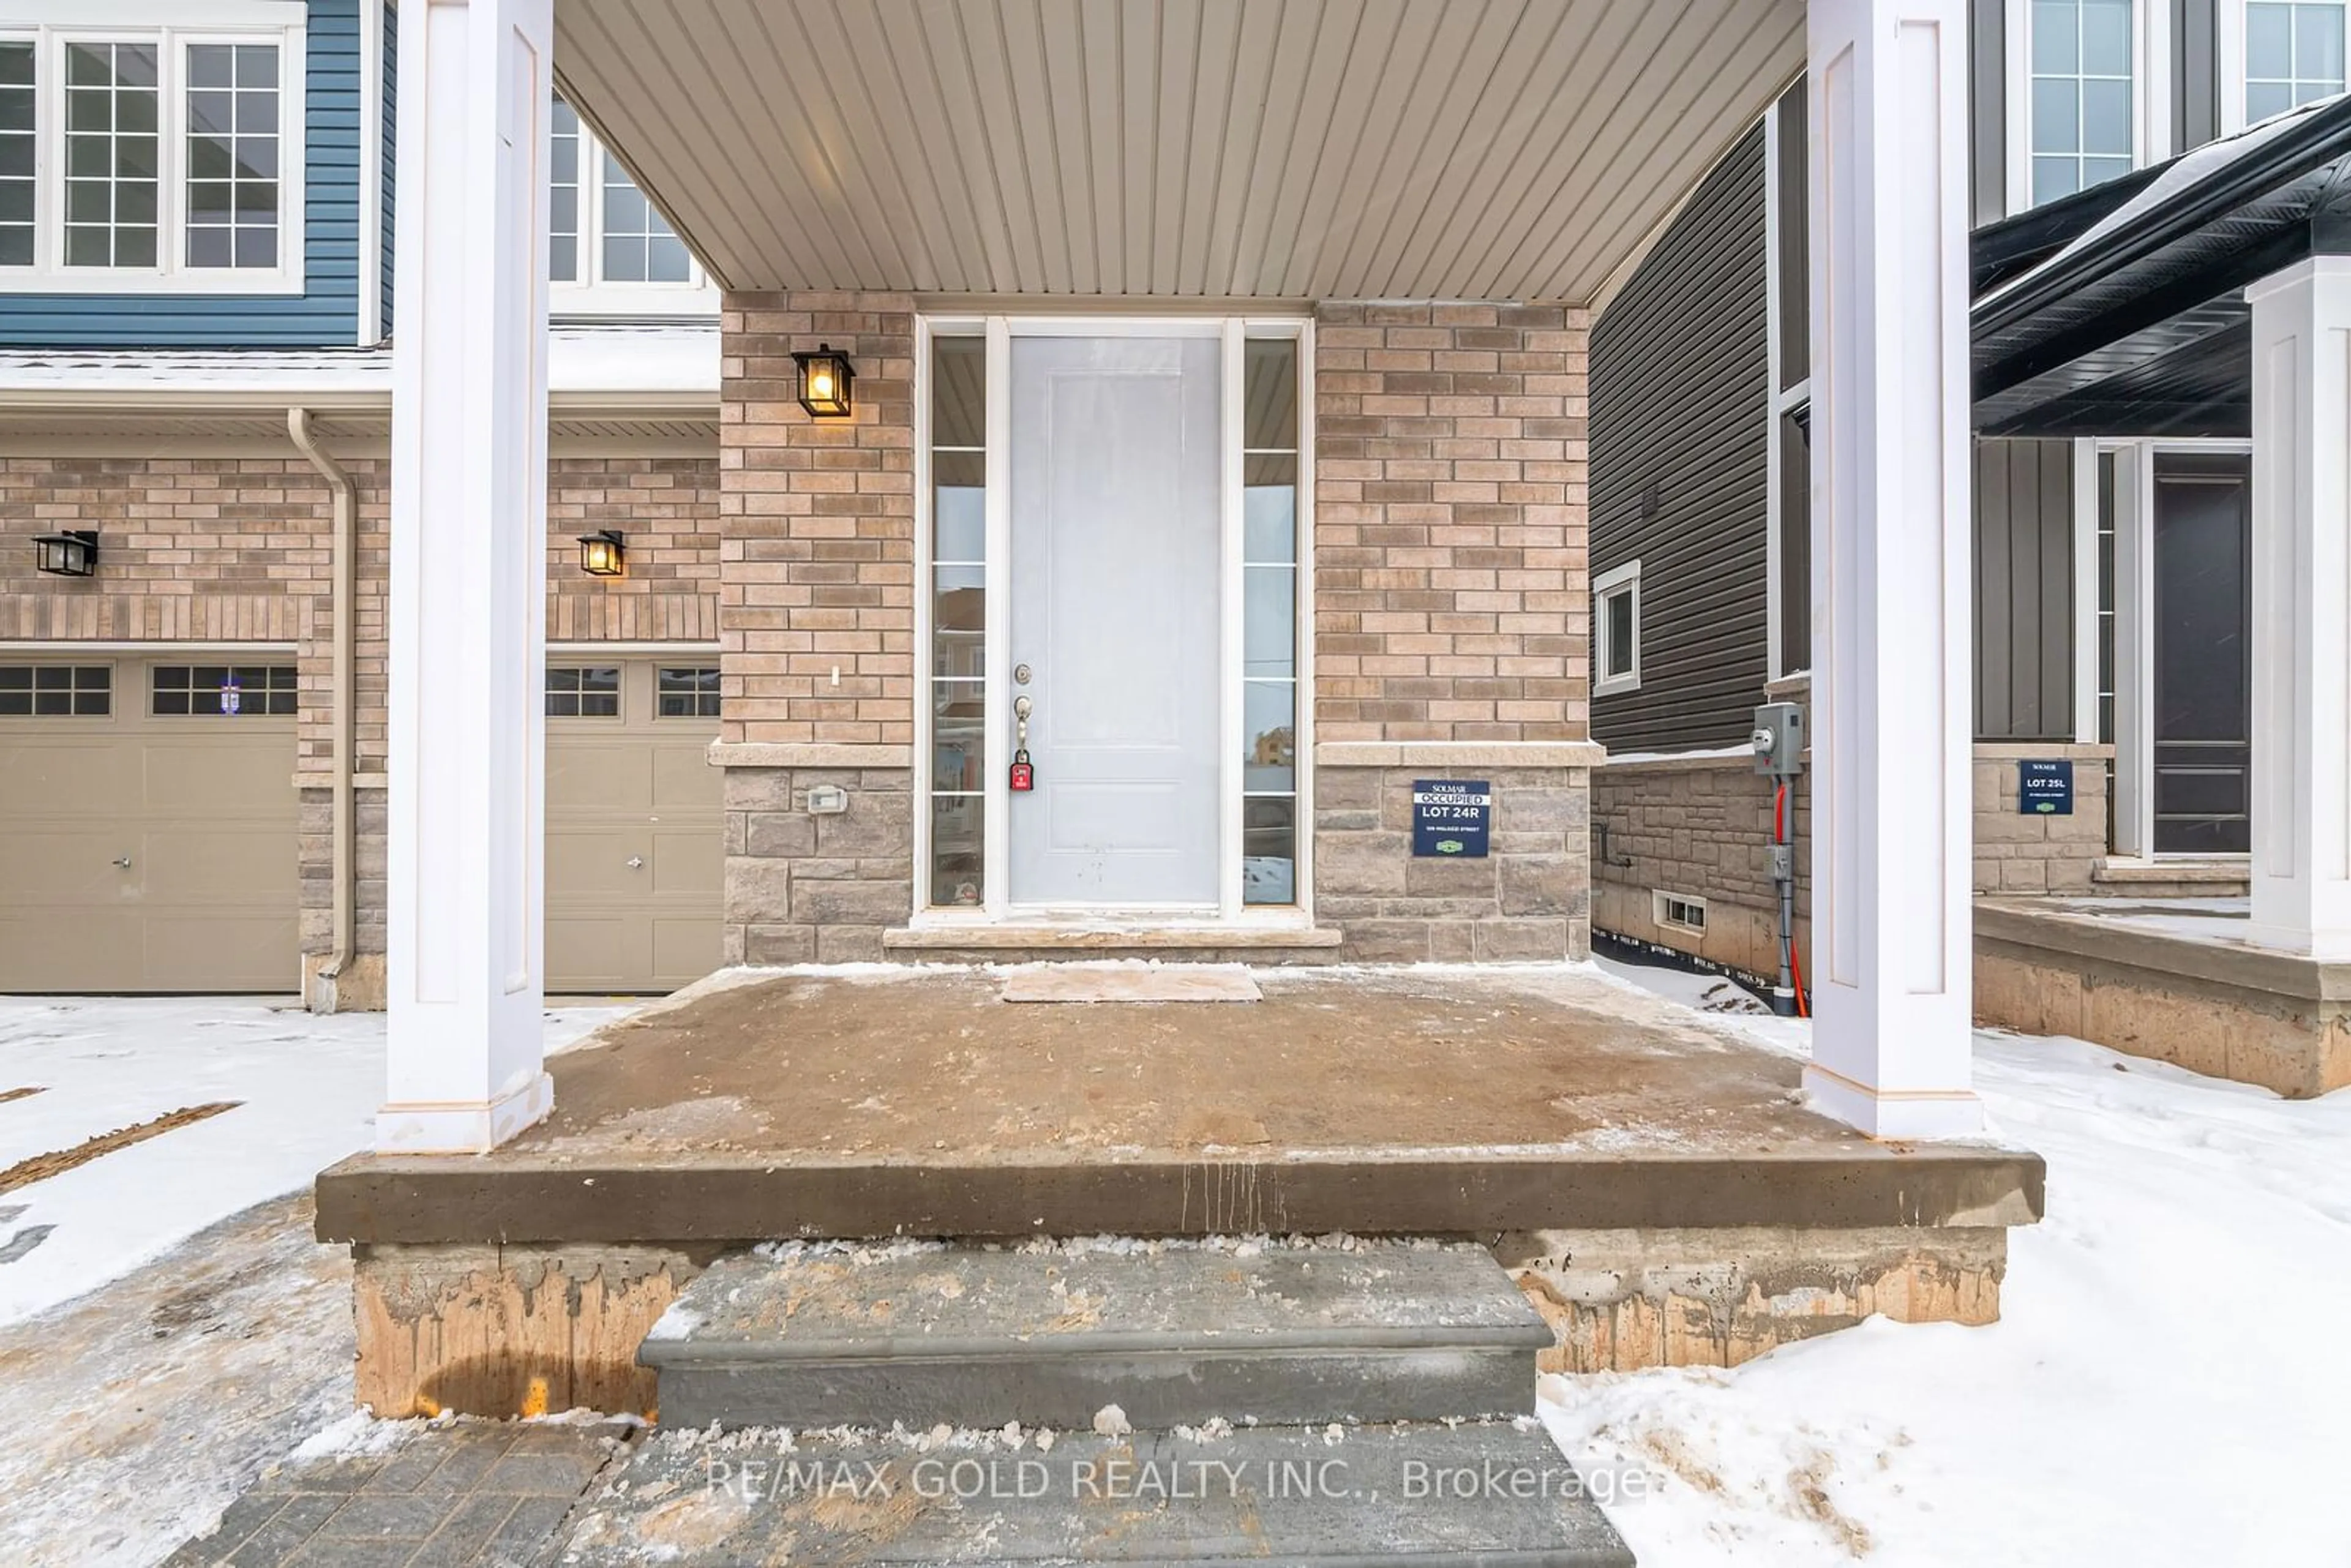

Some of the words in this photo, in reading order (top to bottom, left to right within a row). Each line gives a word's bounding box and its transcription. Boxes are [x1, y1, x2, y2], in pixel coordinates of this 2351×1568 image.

[2027, 779, 2045, 787] LOT
[1422, 795, 1483, 804] OCCUPIED
[1422, 807, 1449, 817] LOT
[1453, 807, 1479, 818] 24R
